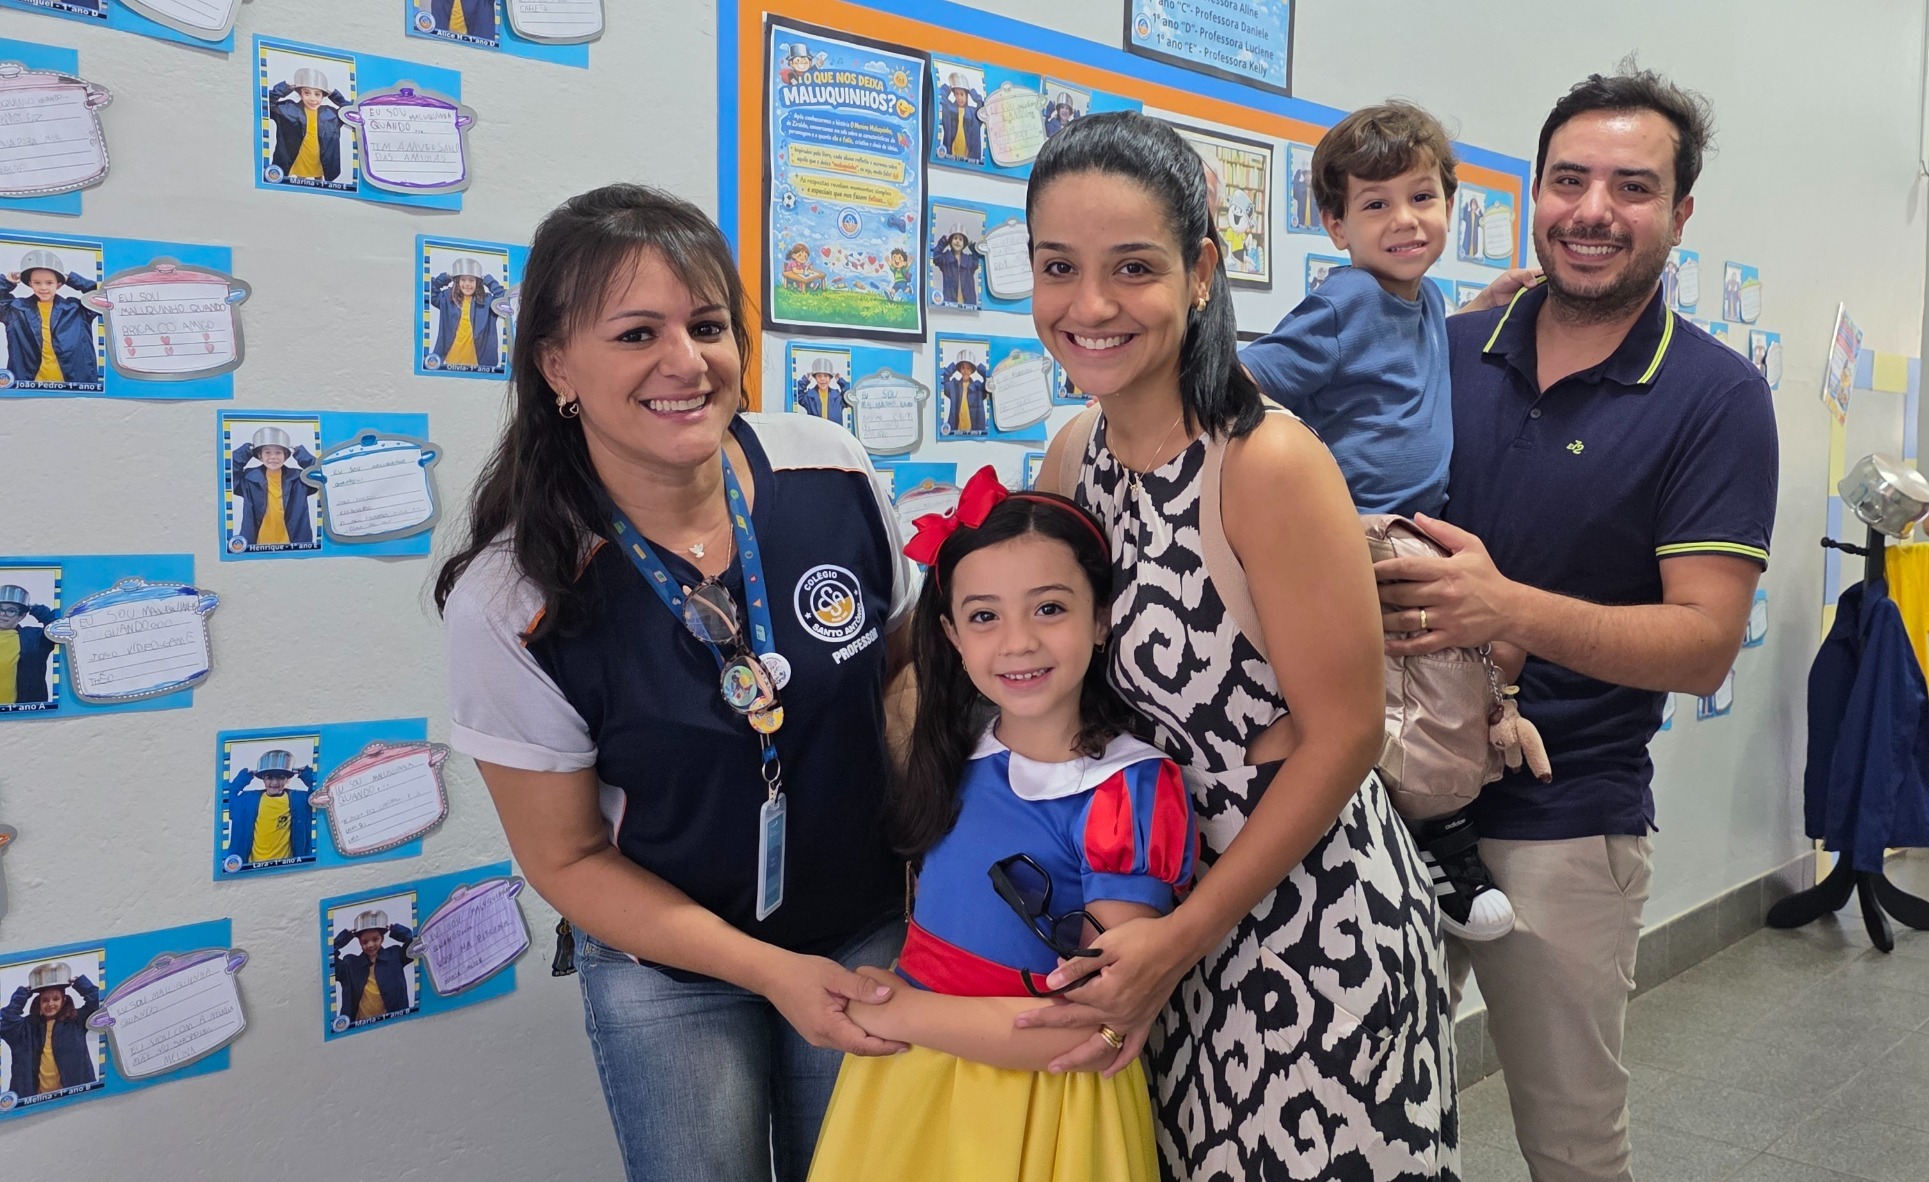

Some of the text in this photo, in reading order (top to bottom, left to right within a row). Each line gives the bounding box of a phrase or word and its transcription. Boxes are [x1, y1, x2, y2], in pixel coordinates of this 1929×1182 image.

[71, 7, 89, 15] ano
[91, 9, 99, 17] D
[1240, 3, 1259, 18] Aline
[1159, 0, 1269, 40] ano Professora Daniele
[436, 30, 456, 38] Alice
[1162, 18, 1179, 30] ano
[1200, 27, 1243, 50] Professora
[1245, 41, 1274, 60] Luciene
[1166, 38, 1183, 51] ano
[1204, 47, 1247, 69] Professora
[1249, 60, 1268, 78] Kelly
[804, 71, 884, 91] O QUE NOS DEIXA
[783, 86, 897, 113] MALUQUINHOS?
[369, 108, 380, 117] EU
[386, 108, 407, 117] SOU
[370, 120, 411, 132] QUANDO
[289, 177, 315, 186] Marina
[119, 291, 160, 302] EU SOU
[121, 303, 227, 315] MALUQUINHO QUANDO
[183, 320, 215, 332] AMIGO
[15, 381, 36, 389] João
[250, 543, 284, 552] Henrique
[804, 570, 838, 591] COLÉGIO
[80, 615, 94, 628] EU
[107, 609, 135, 621] SOU
[812, 623, 844, 638] SANTO
[39, 702, 46, 710] A
[355, 1017, 376, 1027] Maria
[390, 1010, 404, 1018] ano
[24, 1094, 53, 1105] Melina
[68, 1087, 84, 1095] ano
